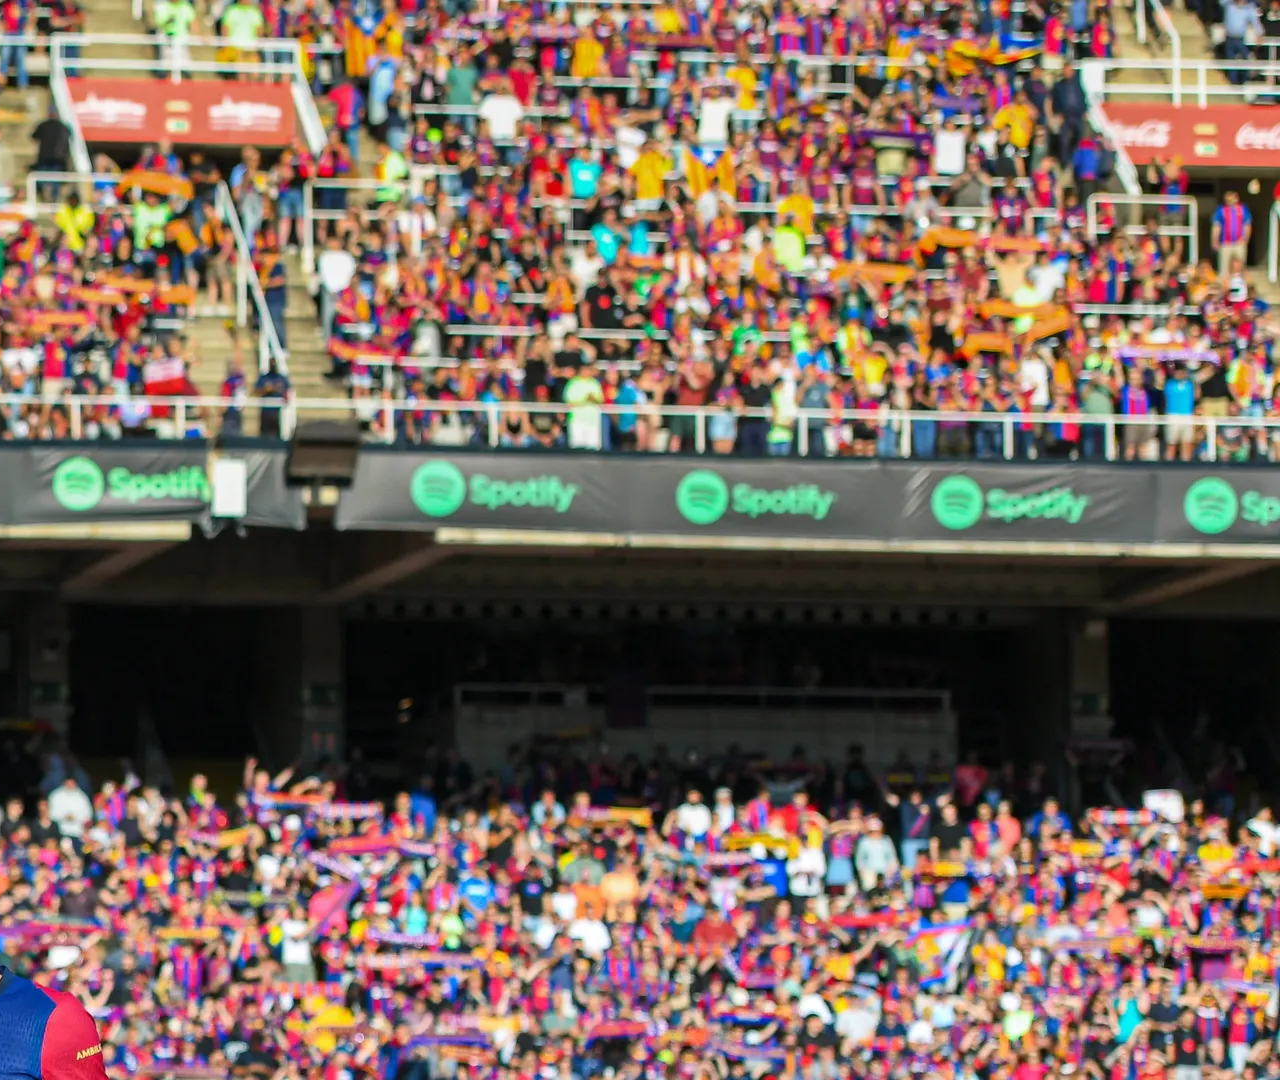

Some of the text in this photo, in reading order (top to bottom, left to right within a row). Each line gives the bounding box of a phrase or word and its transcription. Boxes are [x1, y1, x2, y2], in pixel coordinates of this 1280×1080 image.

[470, 471, 580, 513] Spotify
[732, 483, 835, 521] Spotify
[986, 488, 1090, 526] Spotify
